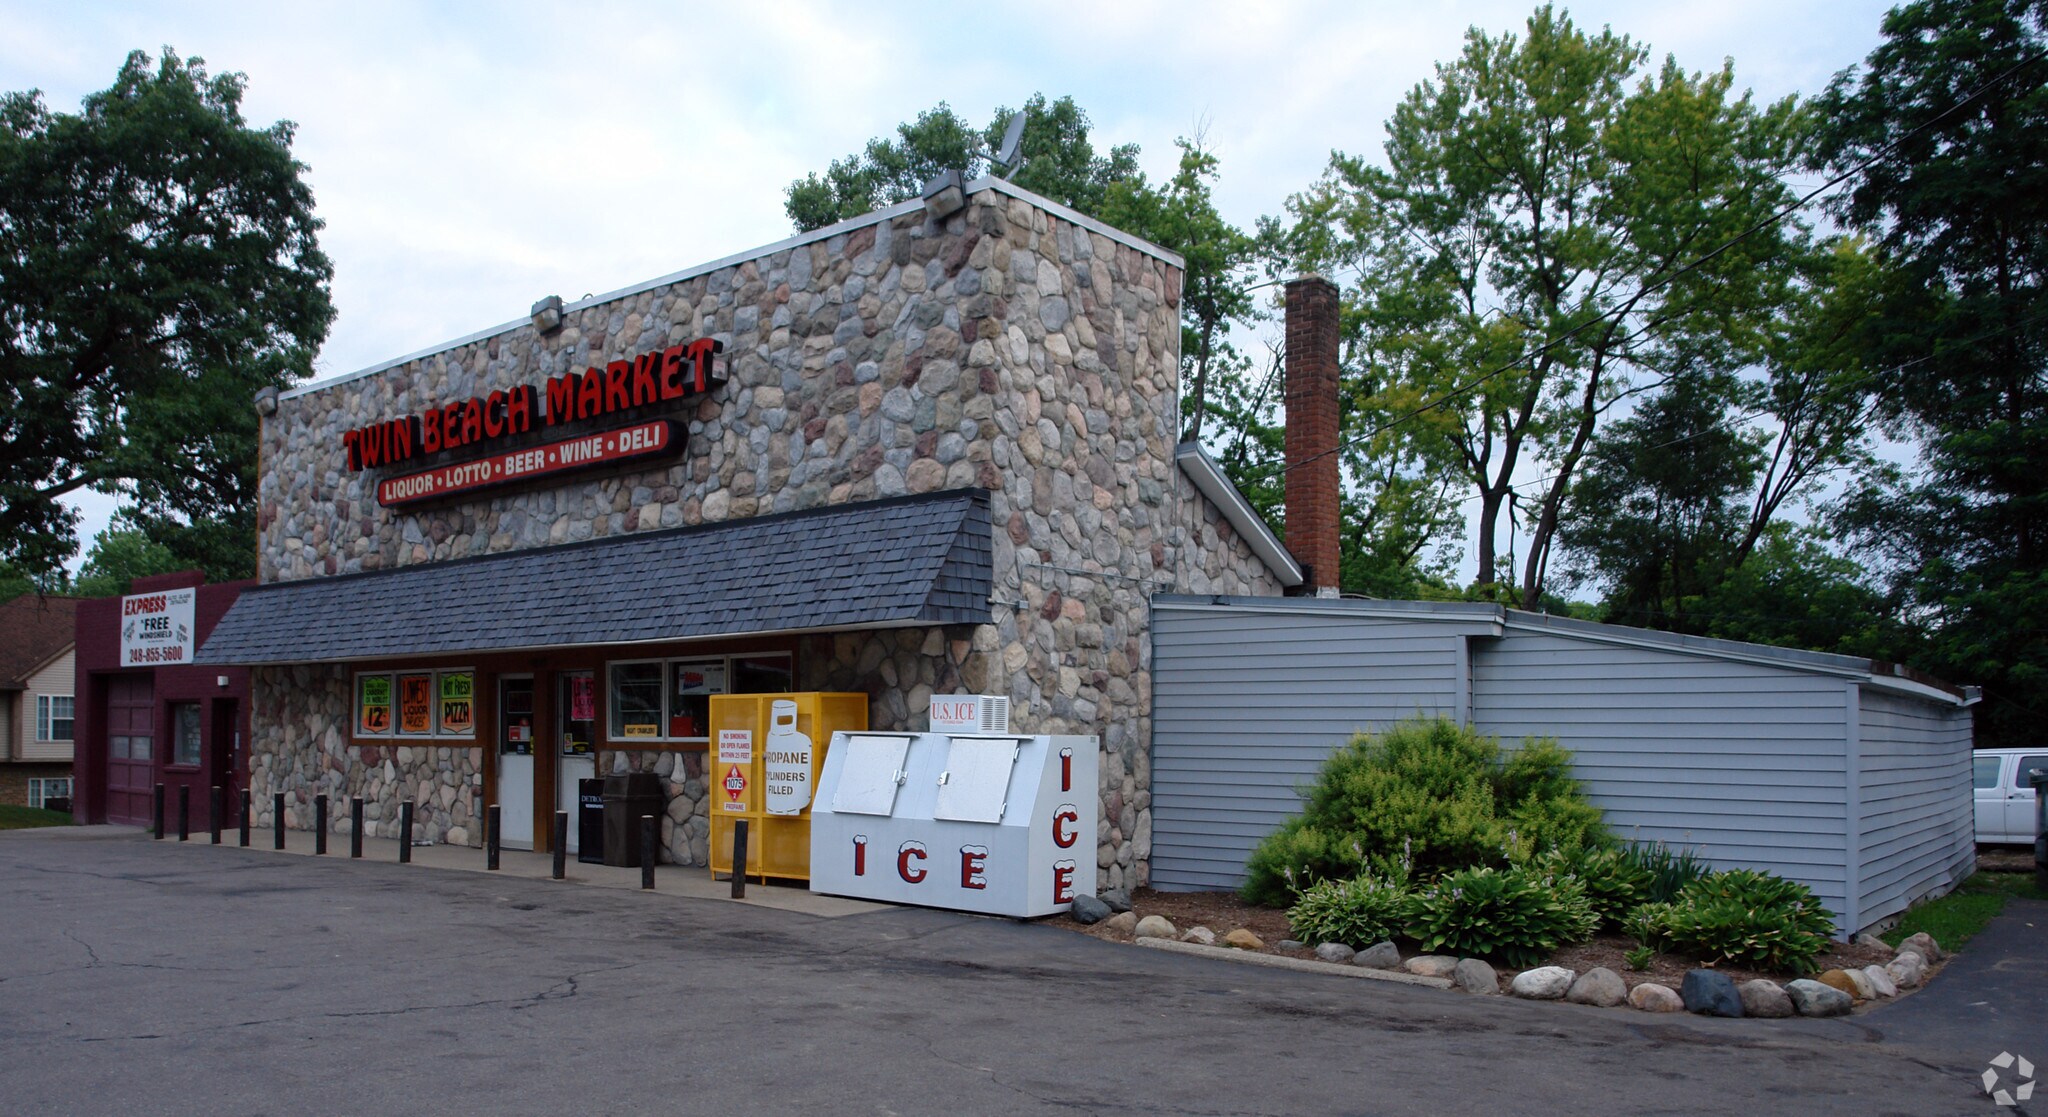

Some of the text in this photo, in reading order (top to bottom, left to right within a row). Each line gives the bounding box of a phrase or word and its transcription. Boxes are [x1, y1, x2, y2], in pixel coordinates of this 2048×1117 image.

[343, 337, 716, 472] TWIN BEACH MARKET
[385, 425, 660, 500] LIQUOR LOTTO BEER WINE DELI
[124, 594, 167, 616] EXPRESS
[139, 630, 173, 640] WINDSHIELD
[129, 645, 183, 663] 248-855-5600
[404, 705, 428, 716] LIQUOR
[444, 702, 470, 723] PIZZA
[932, 702, 975, 720] U.S. ICE
[727, 778, 743, 789] 1075
[768, 785, 793, 795] FILLED
[1052, 747, 1078, 905] ICE
[853, 834, 989, 889] ICE
